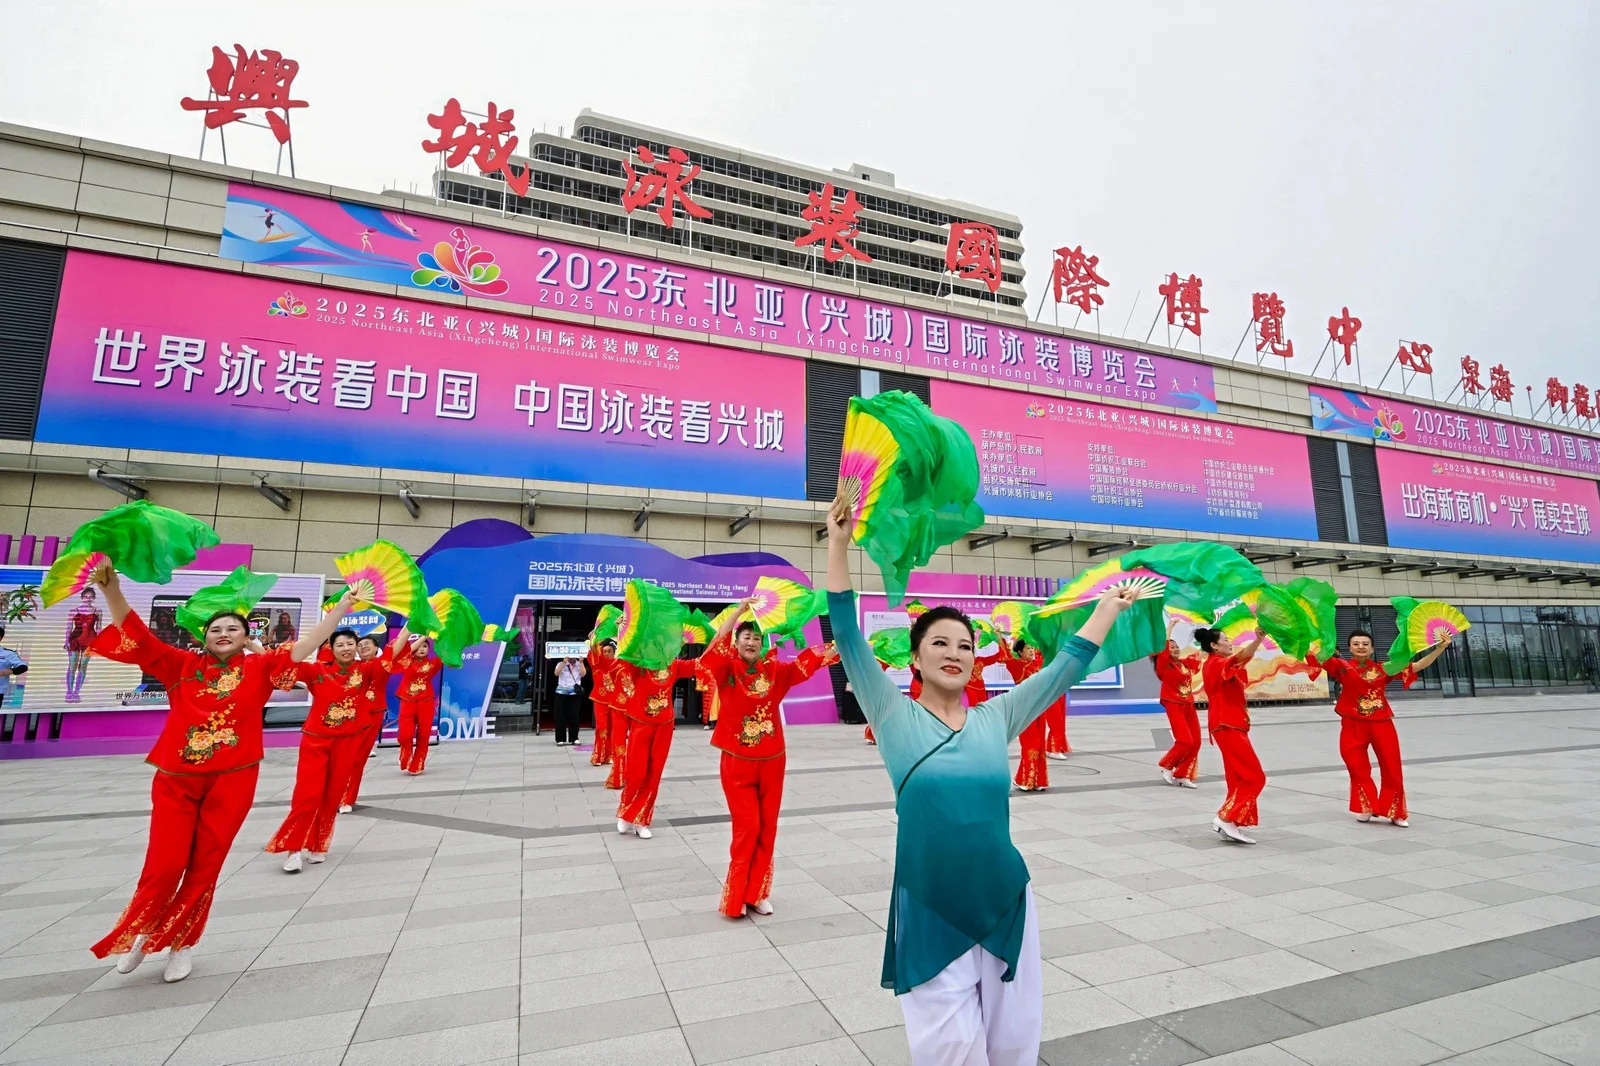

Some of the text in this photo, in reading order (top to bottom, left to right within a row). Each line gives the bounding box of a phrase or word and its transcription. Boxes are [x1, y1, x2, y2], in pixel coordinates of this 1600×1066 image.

[316, 314, 680, 371] 2025 Northeast Asia (Xingcheng) International Swimwear Expo
[539, 288, 1156, 401] 2025 Northeast Asia (Xingcheng) International Swimwear Expo
[92, 327, 784, 453] 世界泳装看中国 中国泳装看兴城
[1412, 408, 1600, 465] 2025东北亚（兴城）国际
[1417, 434, 1439, 446] 2025
[1442, 439, 1487, 454] Northeast
[1490, 446, 1509, 458] Asia
[1567, 458, 1600, 473] Internati
[528, 574, 658, 593] 国际泳装博
[338, 615, 379, 626] 国泳装网
[438, 716, 496, 740] OME
